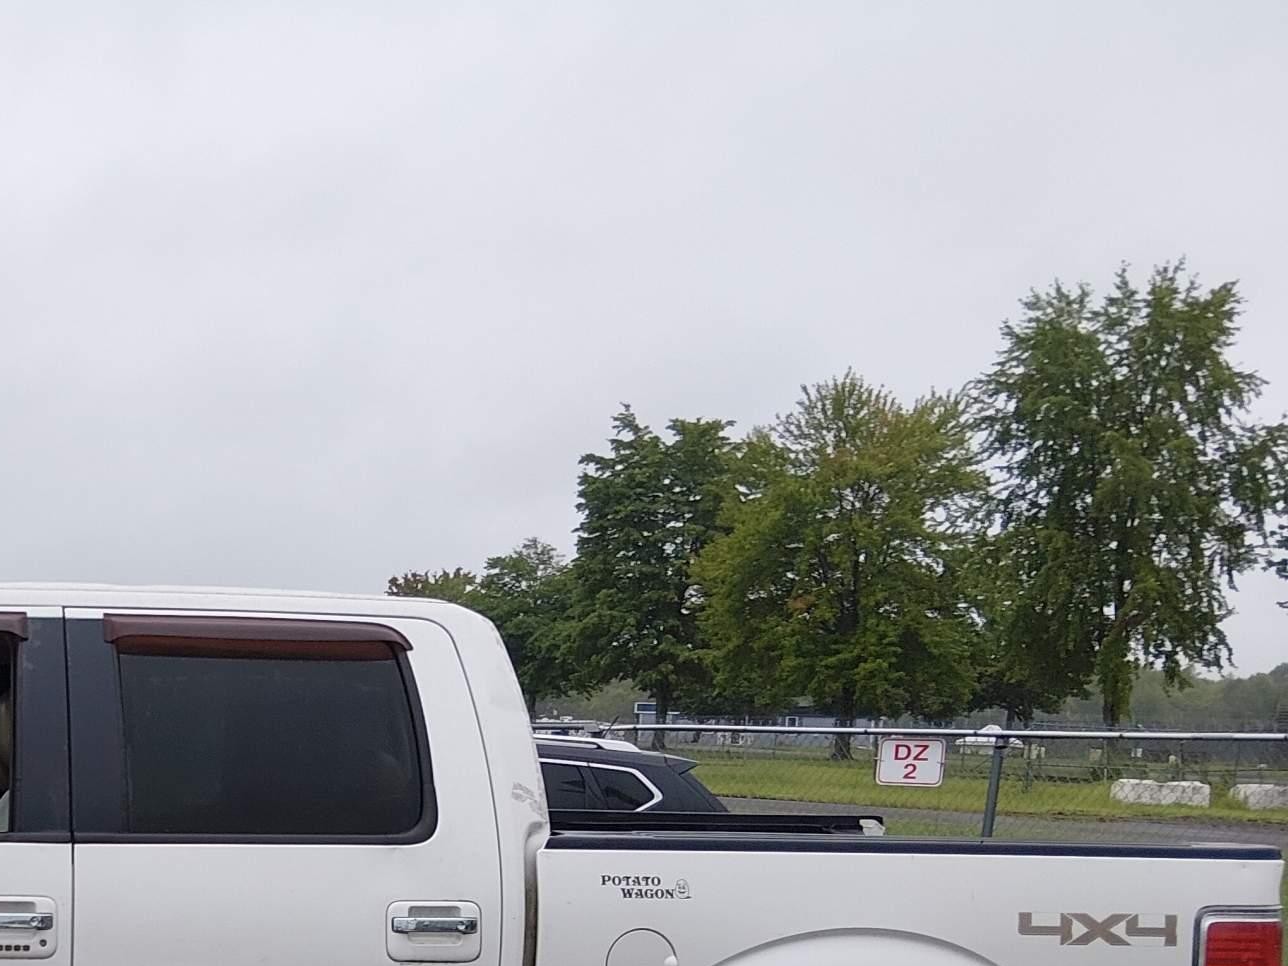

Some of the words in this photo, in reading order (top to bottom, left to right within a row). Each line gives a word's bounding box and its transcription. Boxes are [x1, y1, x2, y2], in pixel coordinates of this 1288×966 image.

[894, 744, 930, 762] DZ
[902, 763, 918, 780] 2
[600, 874, 662, 887] POTATO
[620, 887, 676, 900] WAGON
